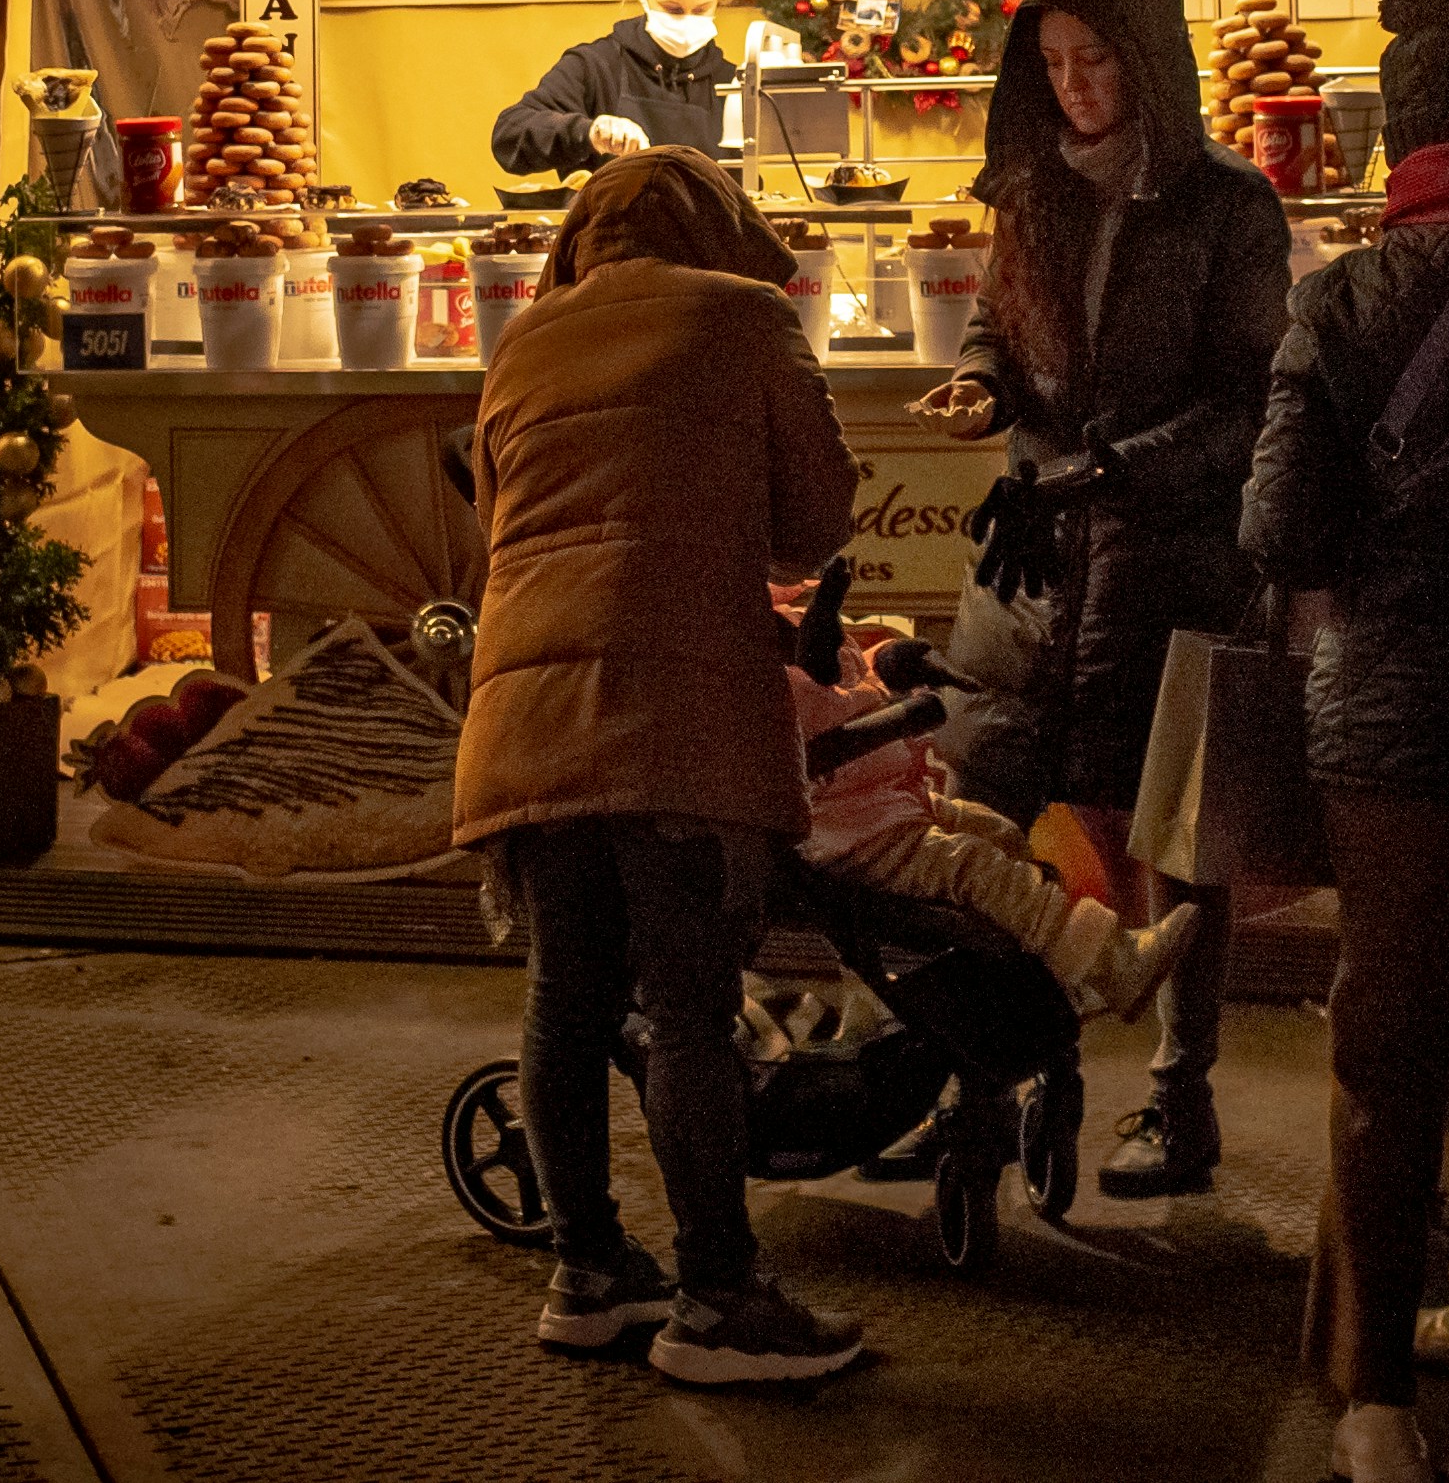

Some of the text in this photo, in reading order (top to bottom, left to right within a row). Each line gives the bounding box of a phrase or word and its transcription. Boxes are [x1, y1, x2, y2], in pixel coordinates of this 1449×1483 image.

[72, 284, 133, 307] nutella
[199, 282, 260, 303] nutella
[336, 281, 401, 304] nutella
